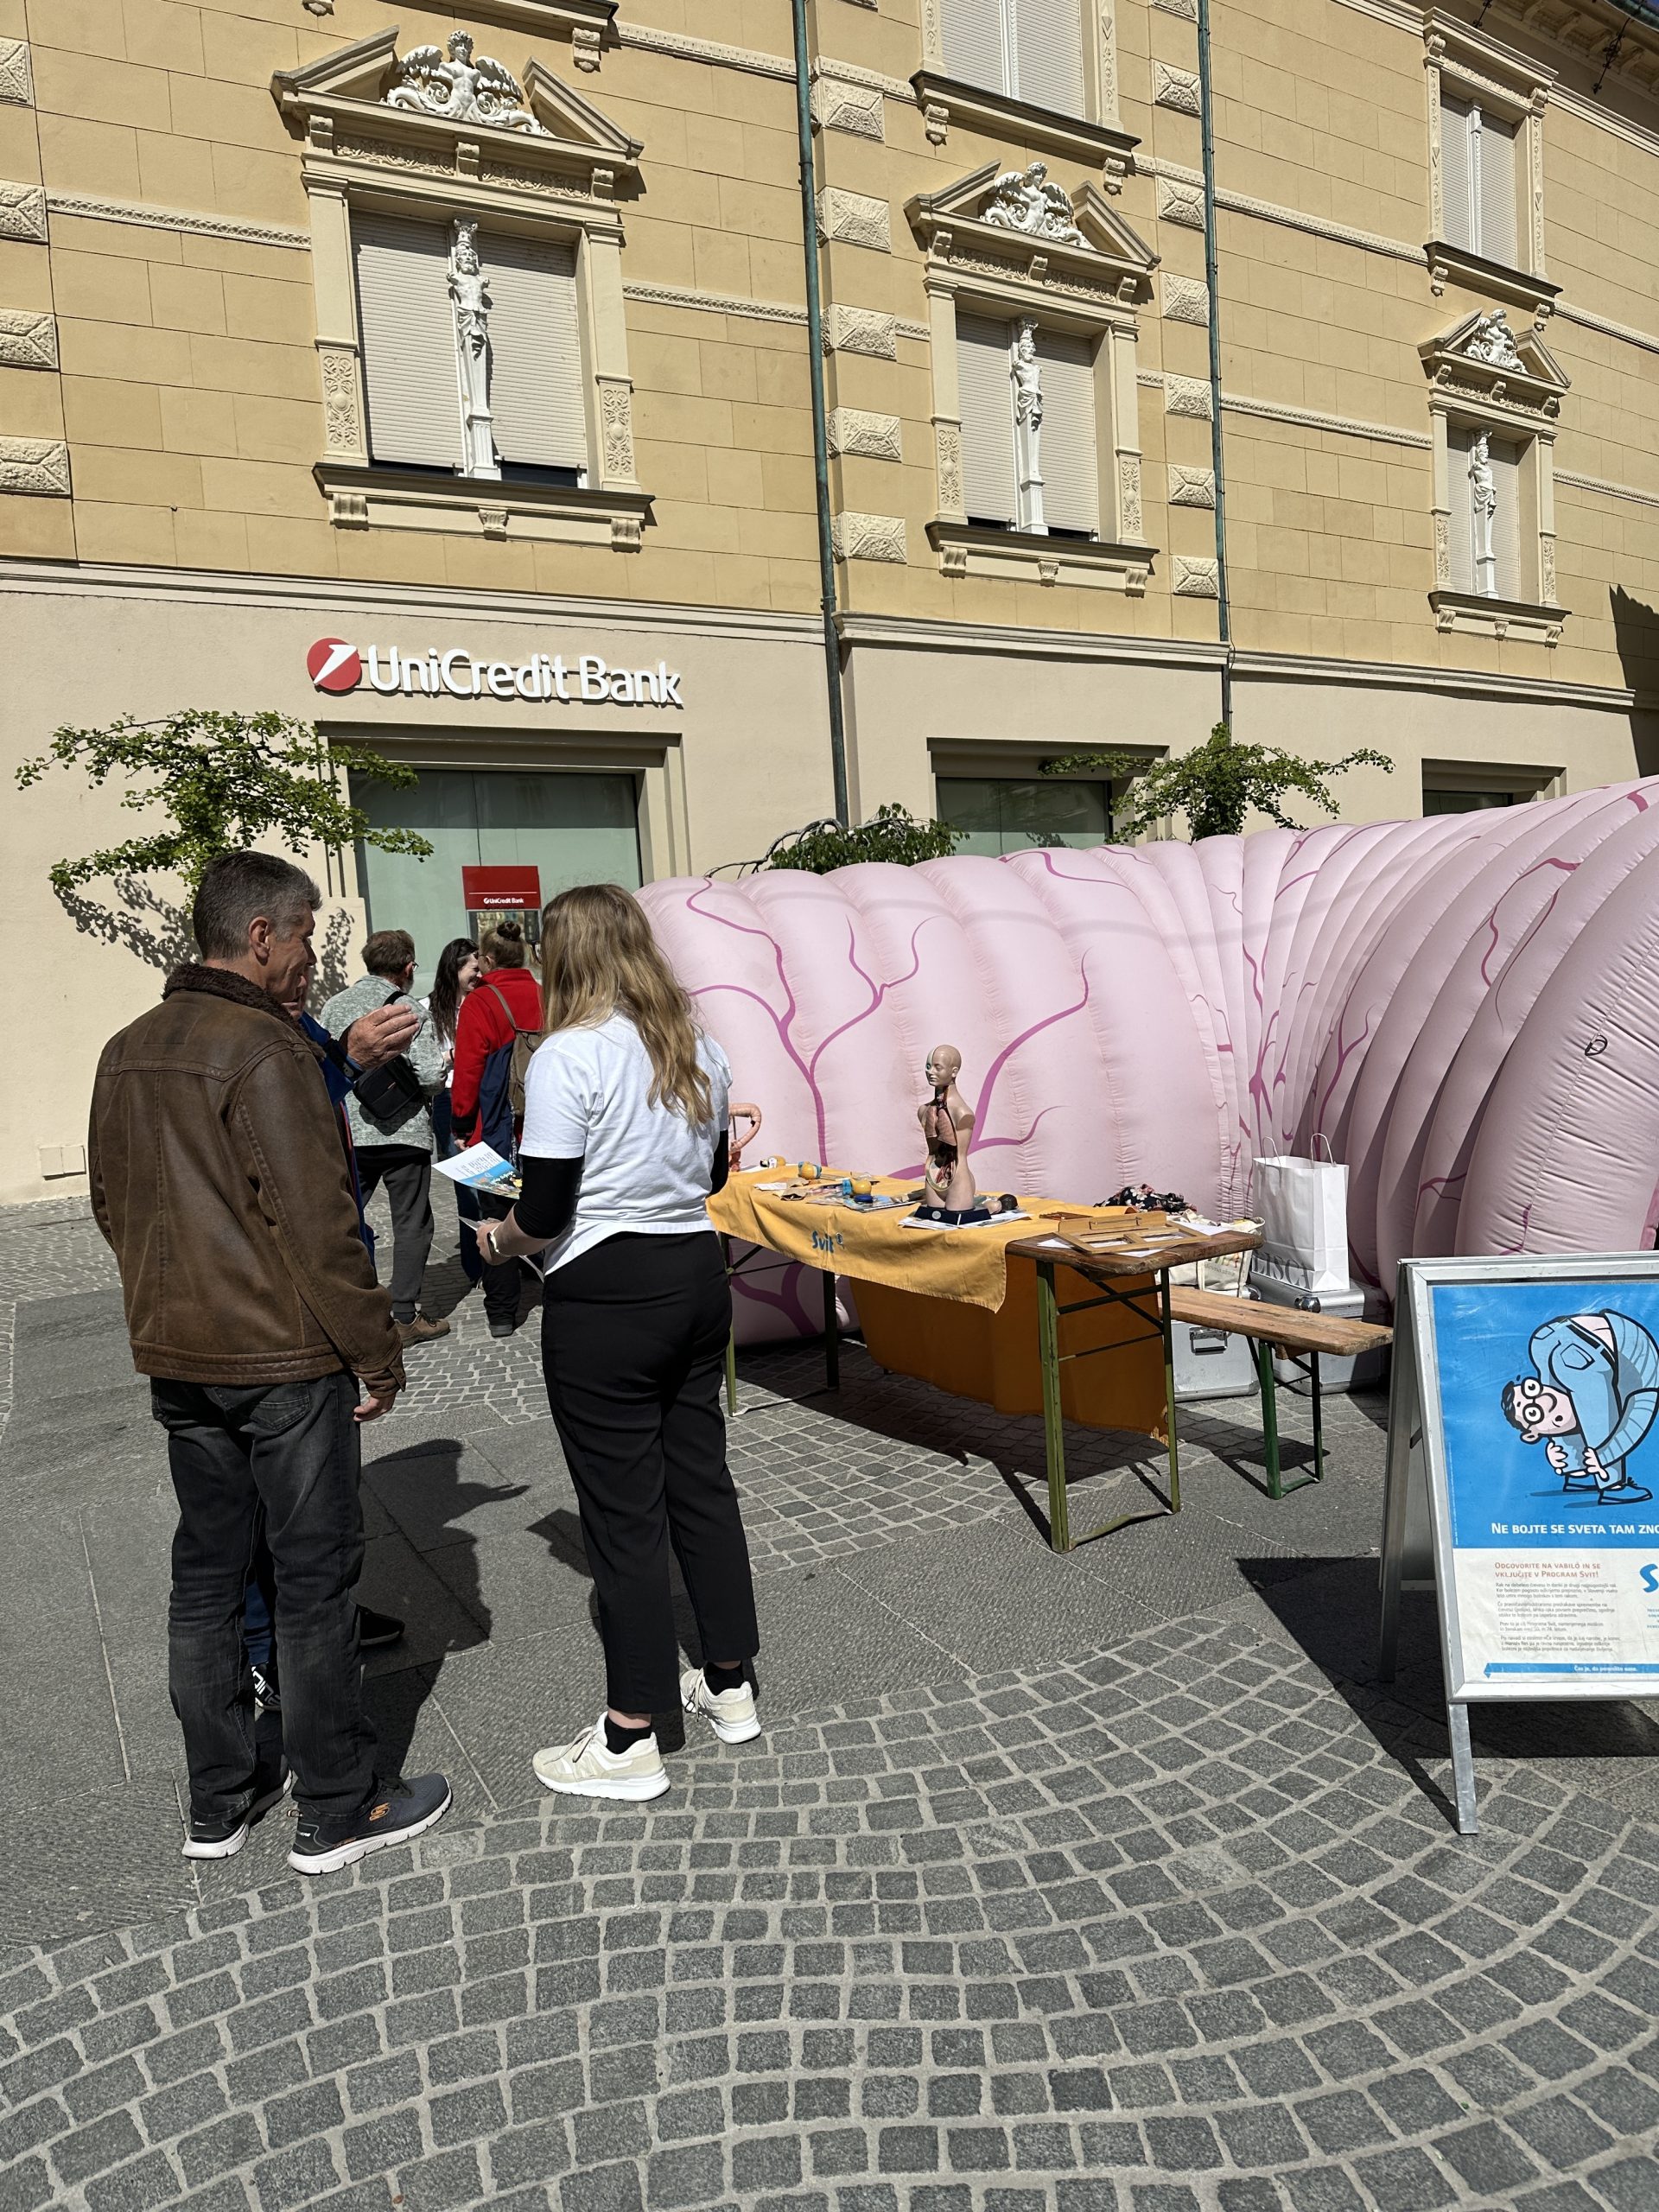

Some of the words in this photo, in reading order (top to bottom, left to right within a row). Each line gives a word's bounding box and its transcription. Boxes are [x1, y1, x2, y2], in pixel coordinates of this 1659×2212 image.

[368, 645, 570, 700] UniCredit
[579, 655, 684, 705] Bank
[811, 1230, 835, 1254] Svit
[1252, 1249, 1314, 1292] LISCA
[1491, 1522, 1509, 1535] NE
[1512, 1524, 1548, 1535] BOJTE
[1550, 1524, 1566, 1535] SE
[1568, 1524, 1606, 1535] SVETA
[1609, 1524, 1636, 1535] TAM
[1495, 1561, 1541, 1570] ODGOVORITE
